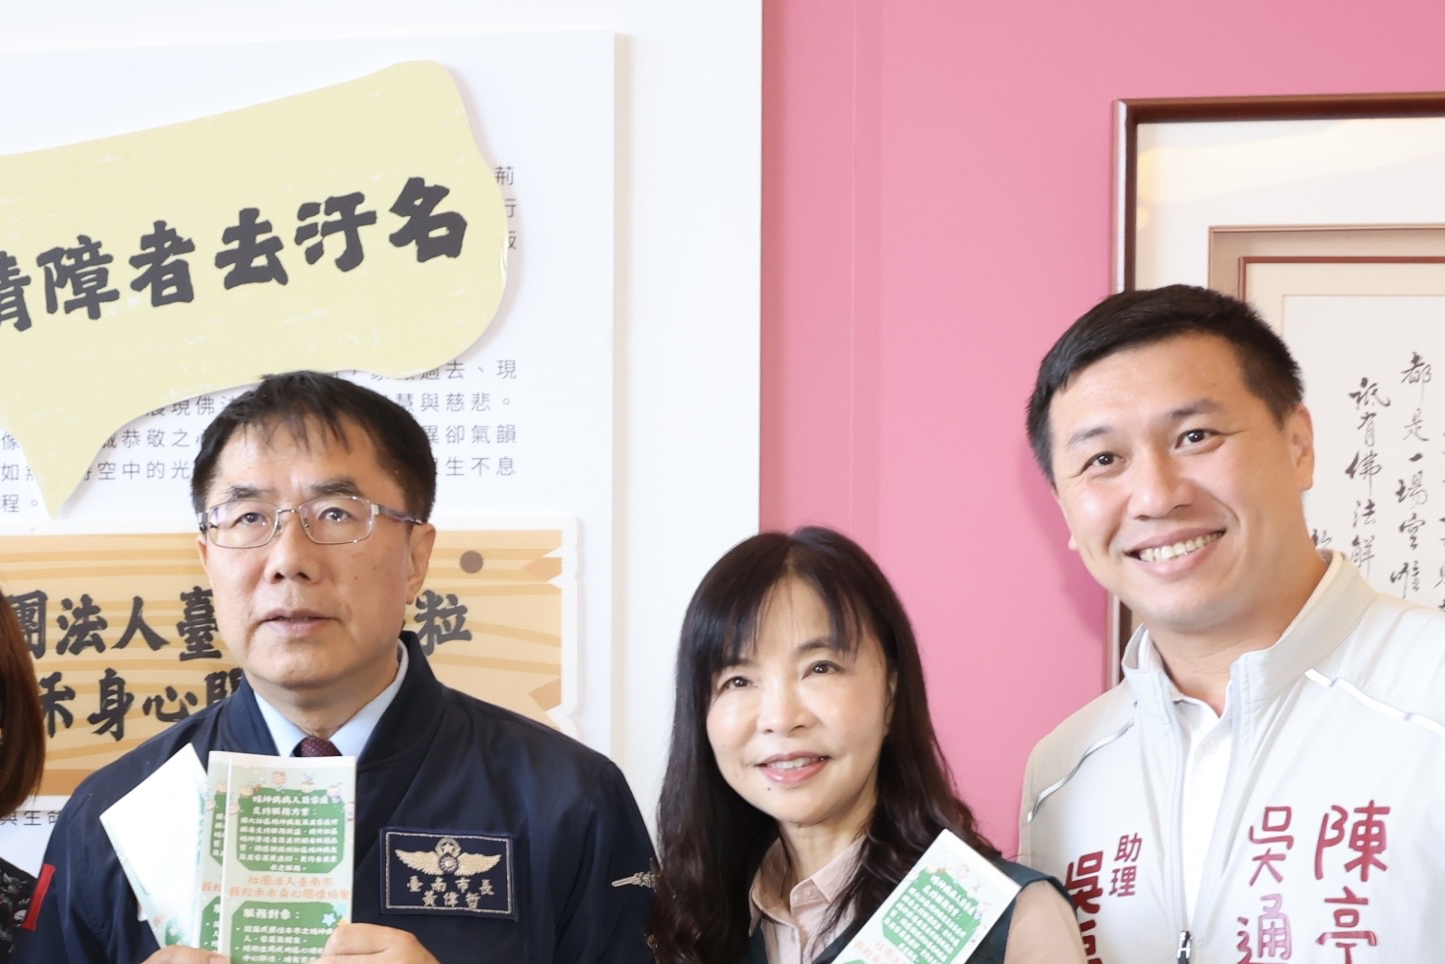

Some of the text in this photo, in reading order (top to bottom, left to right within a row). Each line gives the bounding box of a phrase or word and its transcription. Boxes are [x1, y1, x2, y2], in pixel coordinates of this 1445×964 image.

[84, 460, 191, 481] 空中的光
[1108, 832, 1143, 898] 助理
[406, 875, 495, 896] 臺南市長
[422, 889, 481, 909] 黃偉哲
